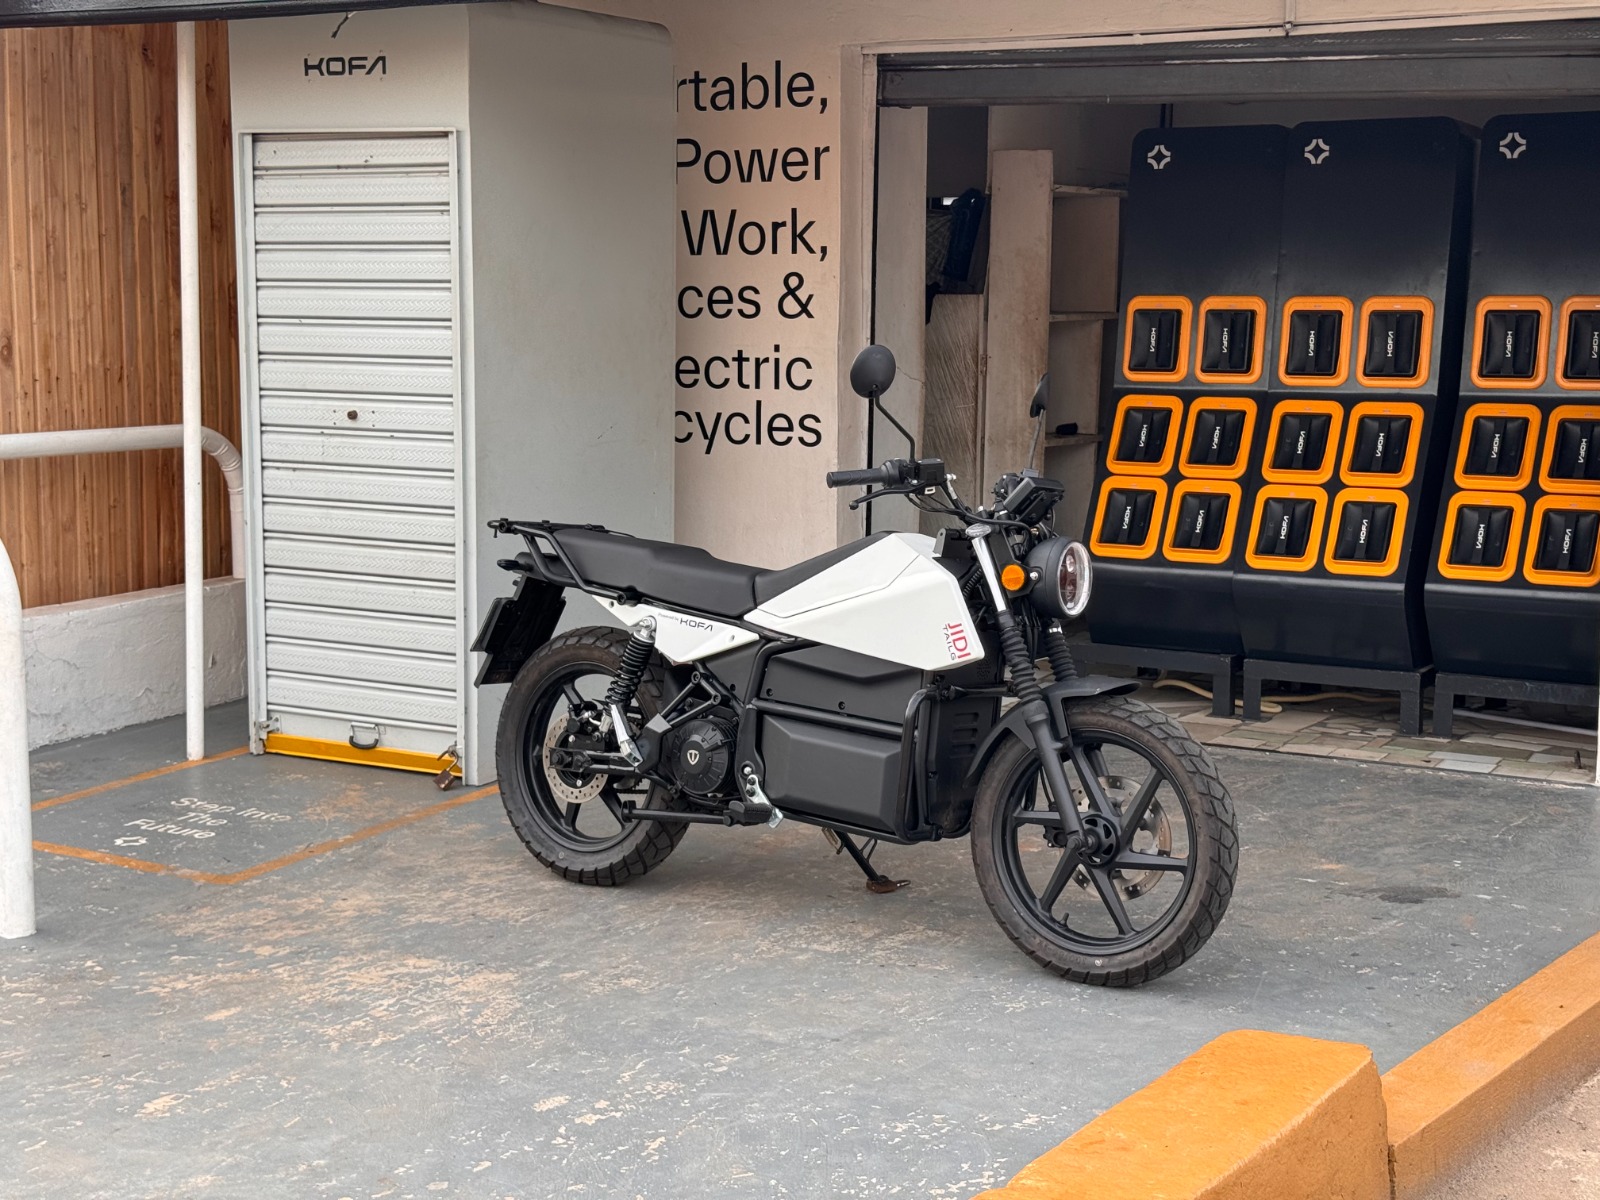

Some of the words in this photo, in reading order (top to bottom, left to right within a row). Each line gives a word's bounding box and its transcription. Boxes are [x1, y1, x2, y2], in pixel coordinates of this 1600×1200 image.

[303, 55, 387, 77] KOFA
[676, 138, 830, 185] Power
[680, 207, 828, 262] Work,
[677, 285, 761, 320] ces
[777, 271, 815, 320] &
[1386, 331, 1394, 357] KOFA
[1505, 331, 1513, 358] KOFA
[1591, 331, 1599, 359] KOFA
[675, 344, 813, 391] ectric
[675, 399, 822, 455] cycles
[1138, 424, 1148, 447] KOFA
[1211, 426, 1221, 449] KOFA
[1296, 430, 1306, 454] KOFA
[1375, 432, 1385, 457] KOFA
[1490, 433, 1501, 458] KOFA
[1577, 438, 1588, 463] KOFA
[1122, 506, 1132, 530] KOFA
[1194, 509, 1205, 533] KOFA
[1279, 515, 1290, 540] KOFA
[1358, 519, 1369, 544] KOFA
[1475, 523, 1486, 549] KOFA
[1562, 528, 1572, 554] KOFA
[680, 617, 714, 632] KOFA
[942, 623, 957, 661] TAILG
[947, 623, 971, 659] JIDI
[170, 797, 236, 813] Step
[123, 818, 216, 839] Future
[177, 811, 228, 826] The
